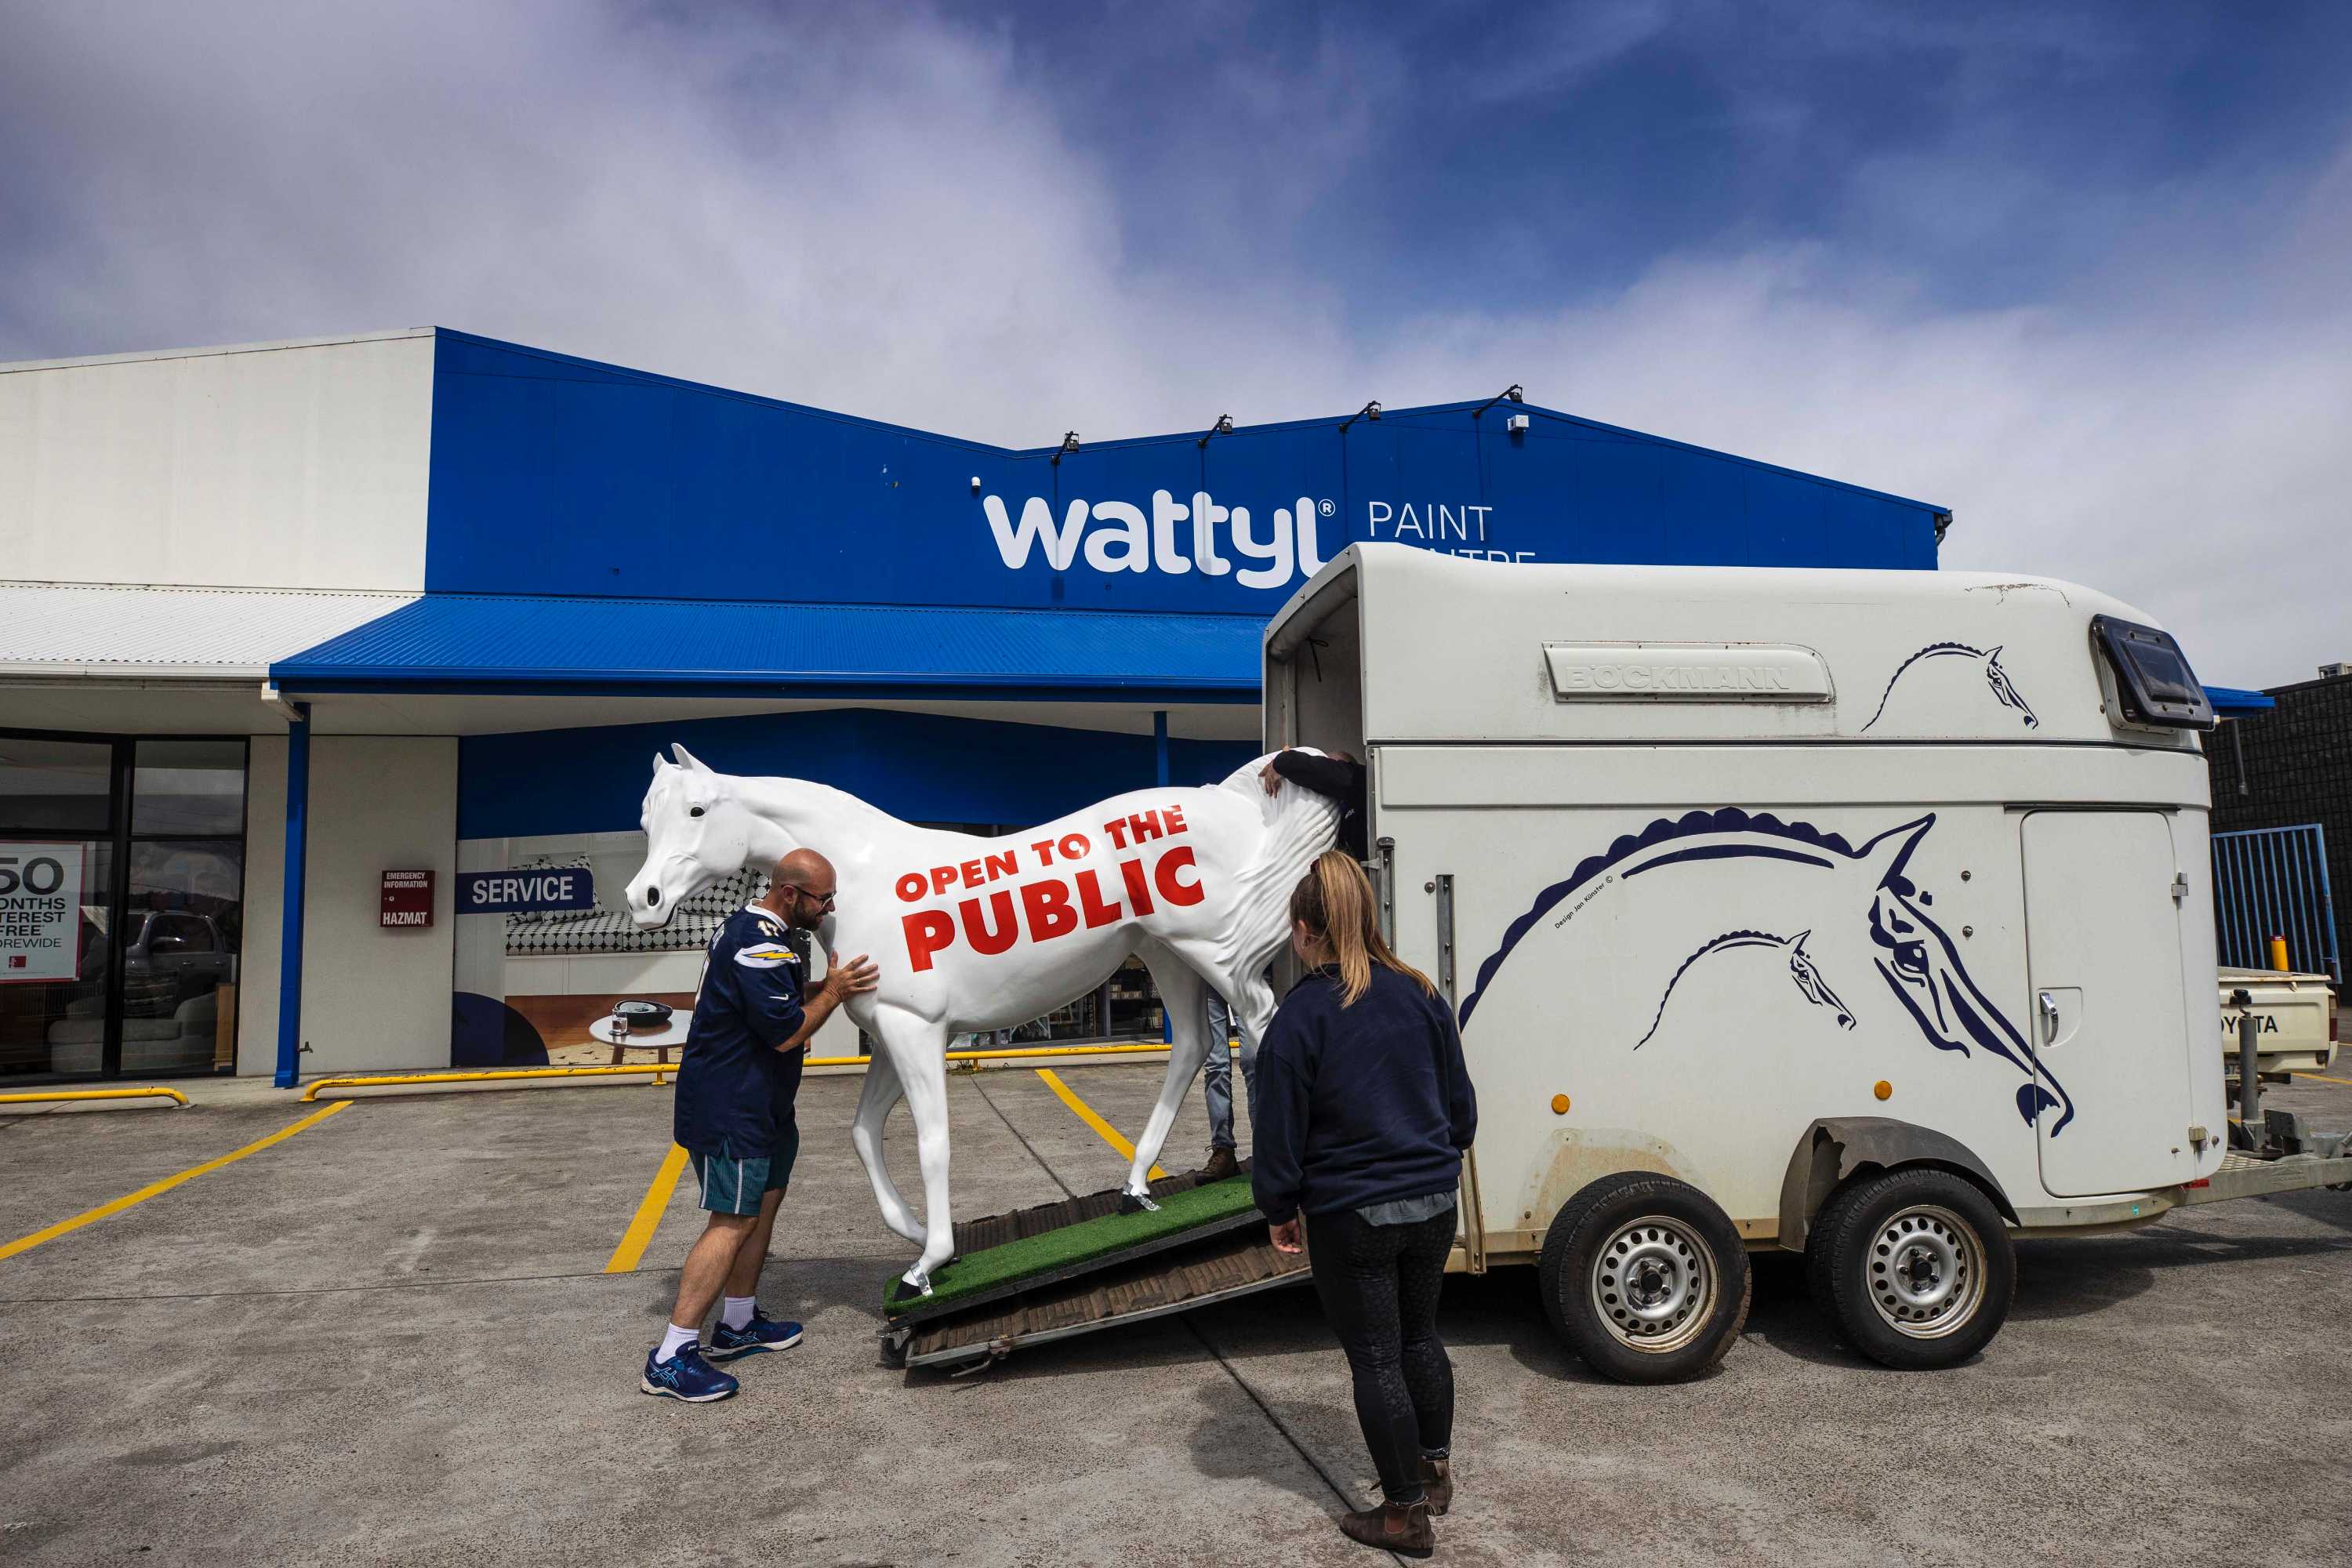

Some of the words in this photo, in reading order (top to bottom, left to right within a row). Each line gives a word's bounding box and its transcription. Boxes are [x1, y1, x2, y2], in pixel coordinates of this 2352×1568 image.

[1369, 501, 1493, 541] PAINT
[895, 850, 1019, 902] OPEN
[1031, 833, 1091, 866] TO
[1104, 804, 1188, 850] THE
[472, 876, 574, 904] SERVICE
[383, 912, 427, 925] HAZMAT
[902, 846, 1205, 972] PUBLIC
[1555, 911, 1574, 929] Design
[1573, 902, 1584, 912] Jan
[0, 938, 62, 948] REWIDE
[2220, 1015, 2278, 1034] YTA
